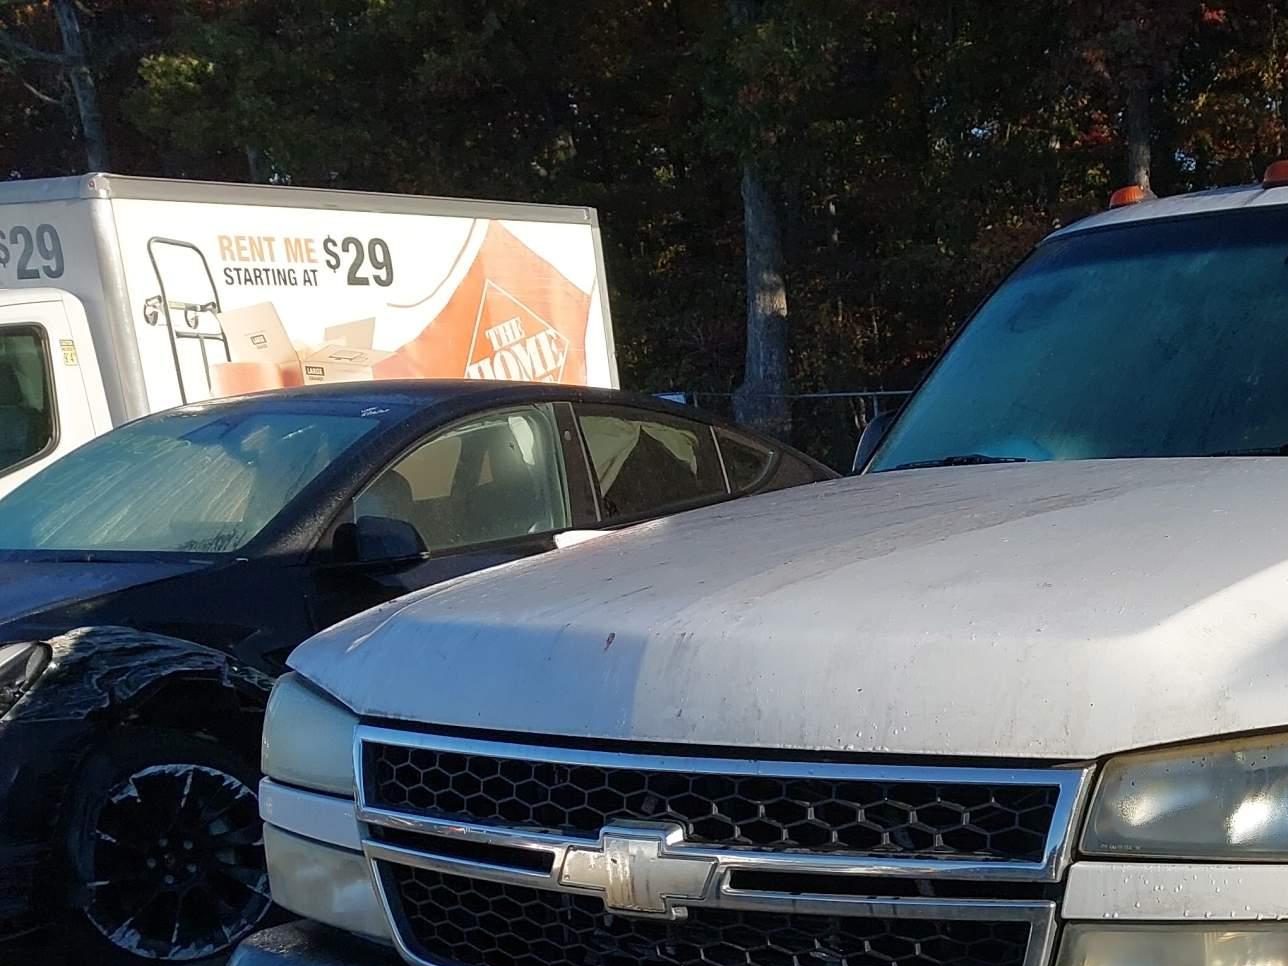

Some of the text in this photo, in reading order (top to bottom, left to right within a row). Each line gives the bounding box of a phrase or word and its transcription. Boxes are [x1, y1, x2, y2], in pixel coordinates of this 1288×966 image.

[217, 234, 319, 263] RENT ME
[323, 234, 394, 287] $29
[223, 267, 318, 287] STARTING AT
[485, 317, 525, 351] THE
